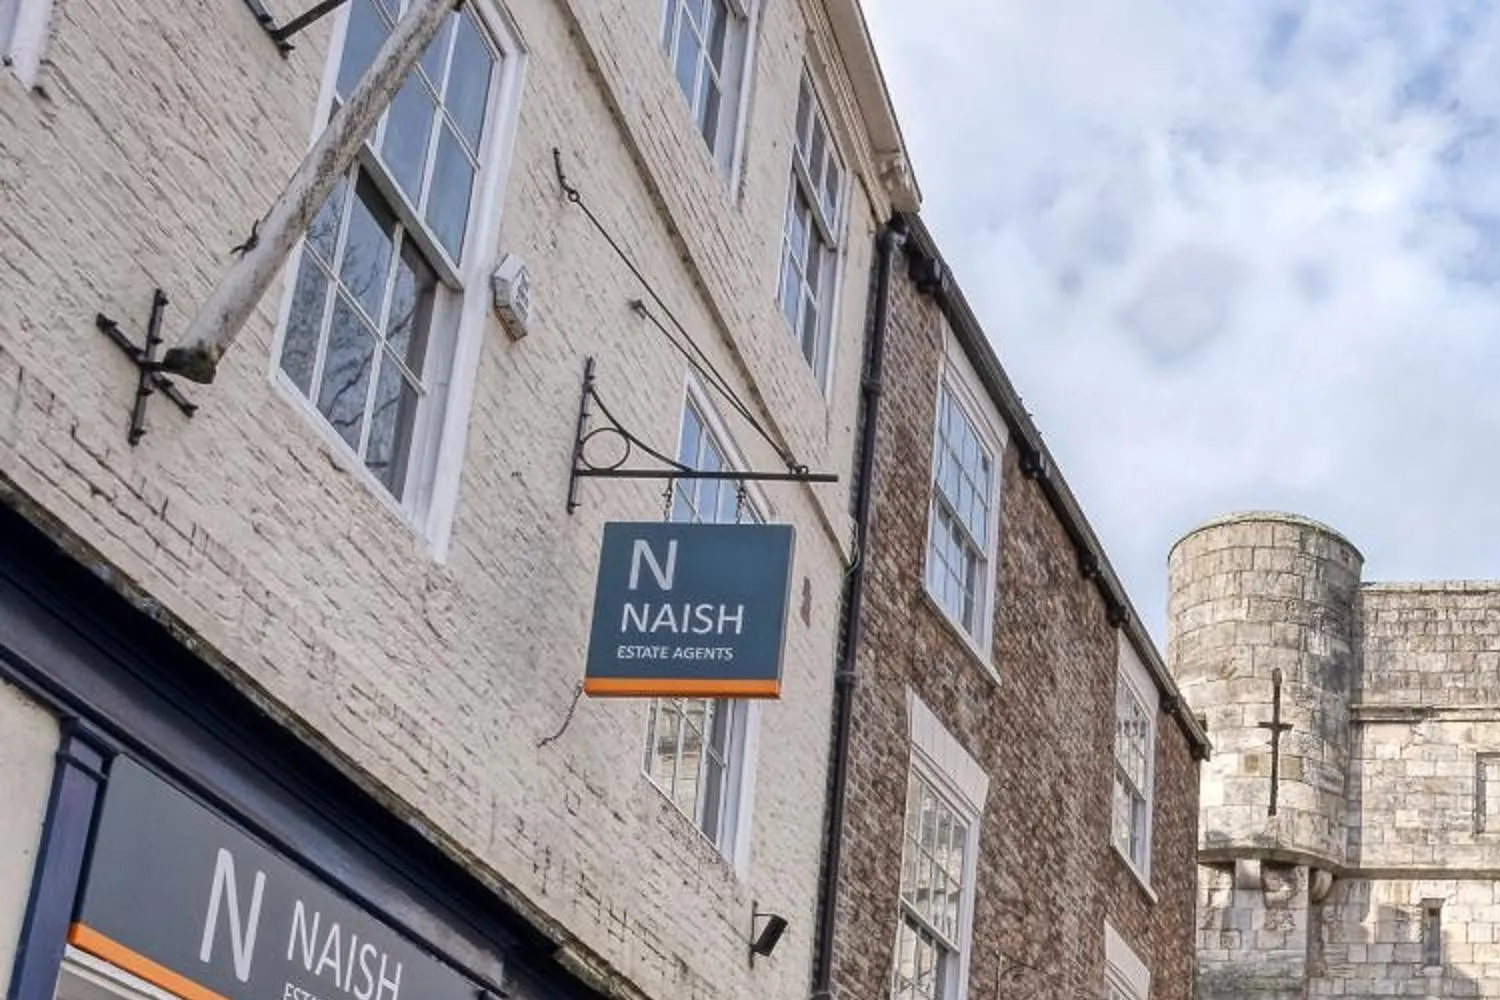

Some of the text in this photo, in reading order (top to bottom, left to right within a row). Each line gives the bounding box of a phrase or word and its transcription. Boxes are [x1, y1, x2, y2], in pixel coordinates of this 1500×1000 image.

[628, 539, 678, 591] N
[621, 603, 745, 635] NAISH
[617, 645, 734, 661] ESTATE AGENTS
[200, 848, 266, 982] N
